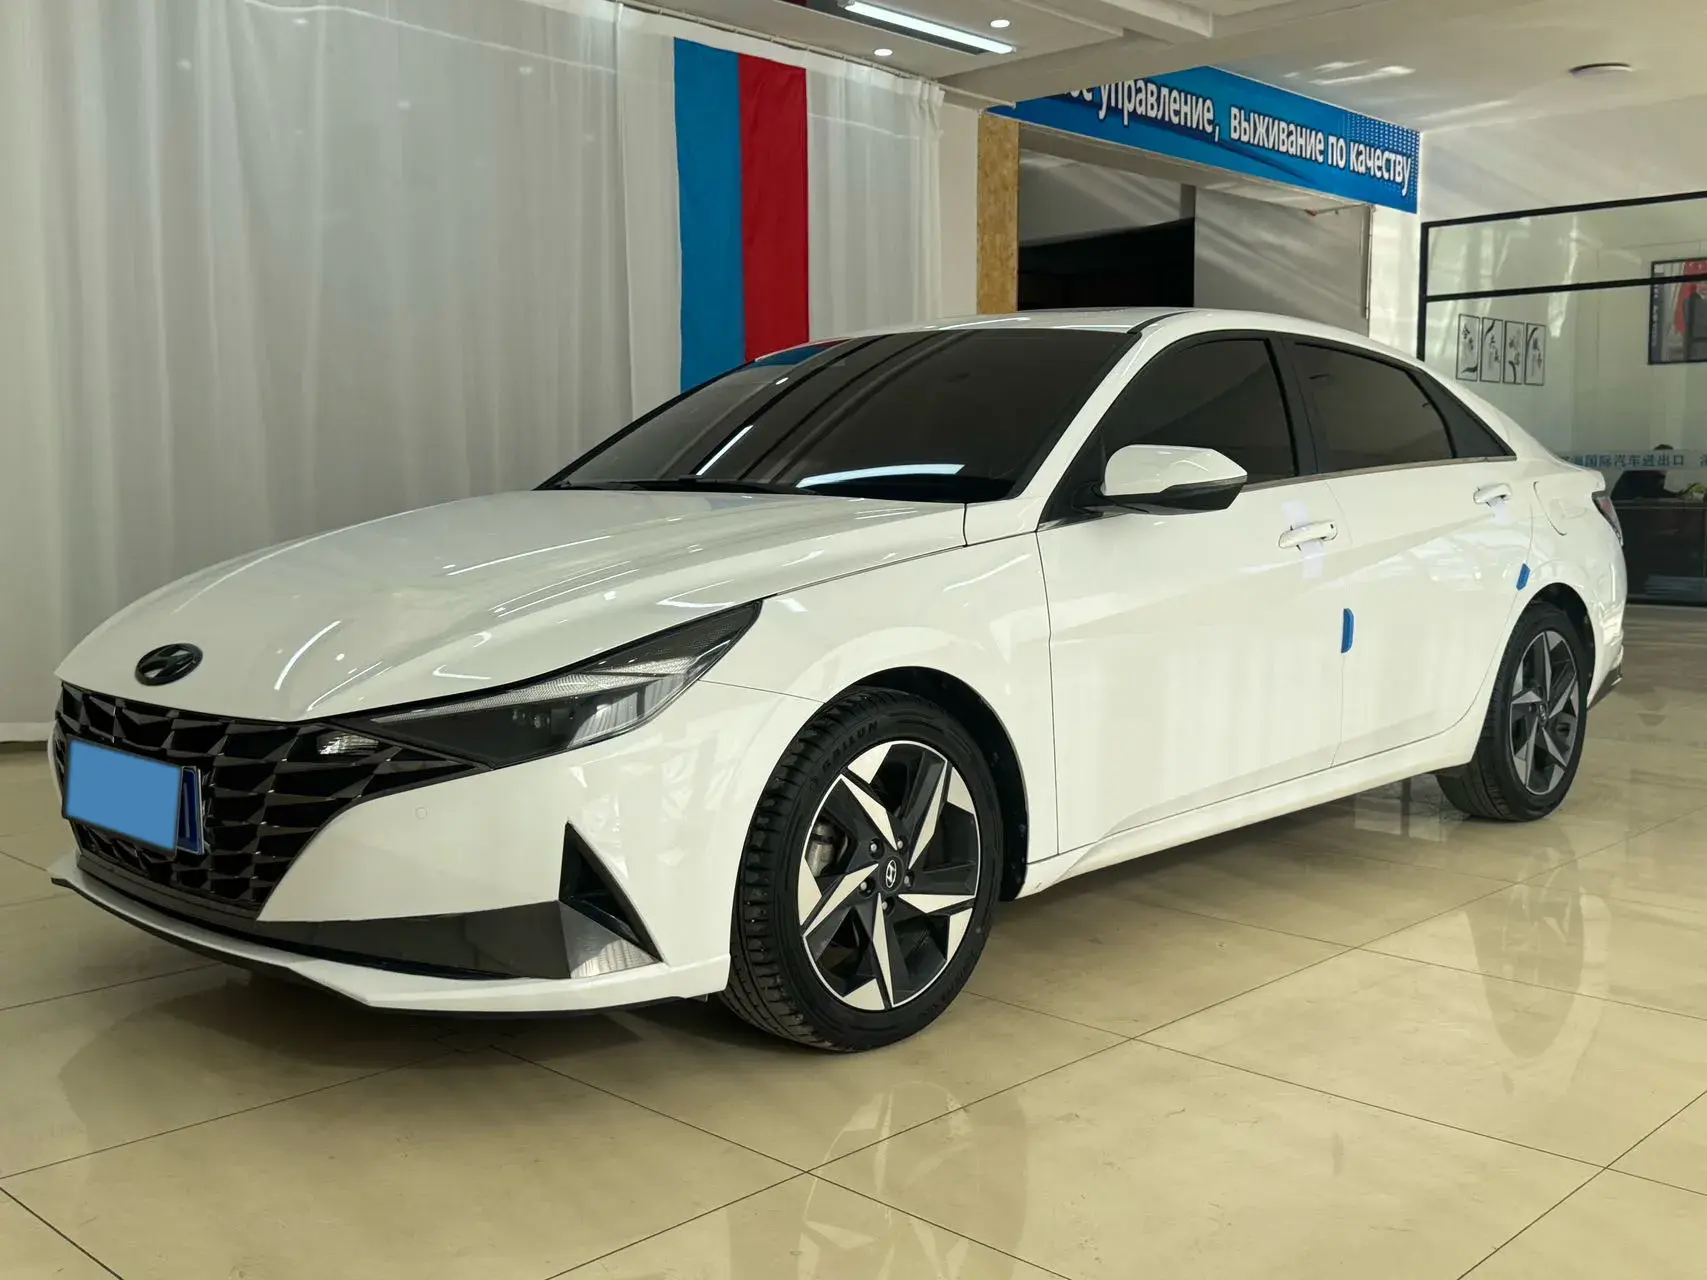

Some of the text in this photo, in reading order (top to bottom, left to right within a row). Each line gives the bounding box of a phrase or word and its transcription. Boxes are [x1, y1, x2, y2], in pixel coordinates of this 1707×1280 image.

[1098, 79, 1411, 197] управление, выживание по качеству
